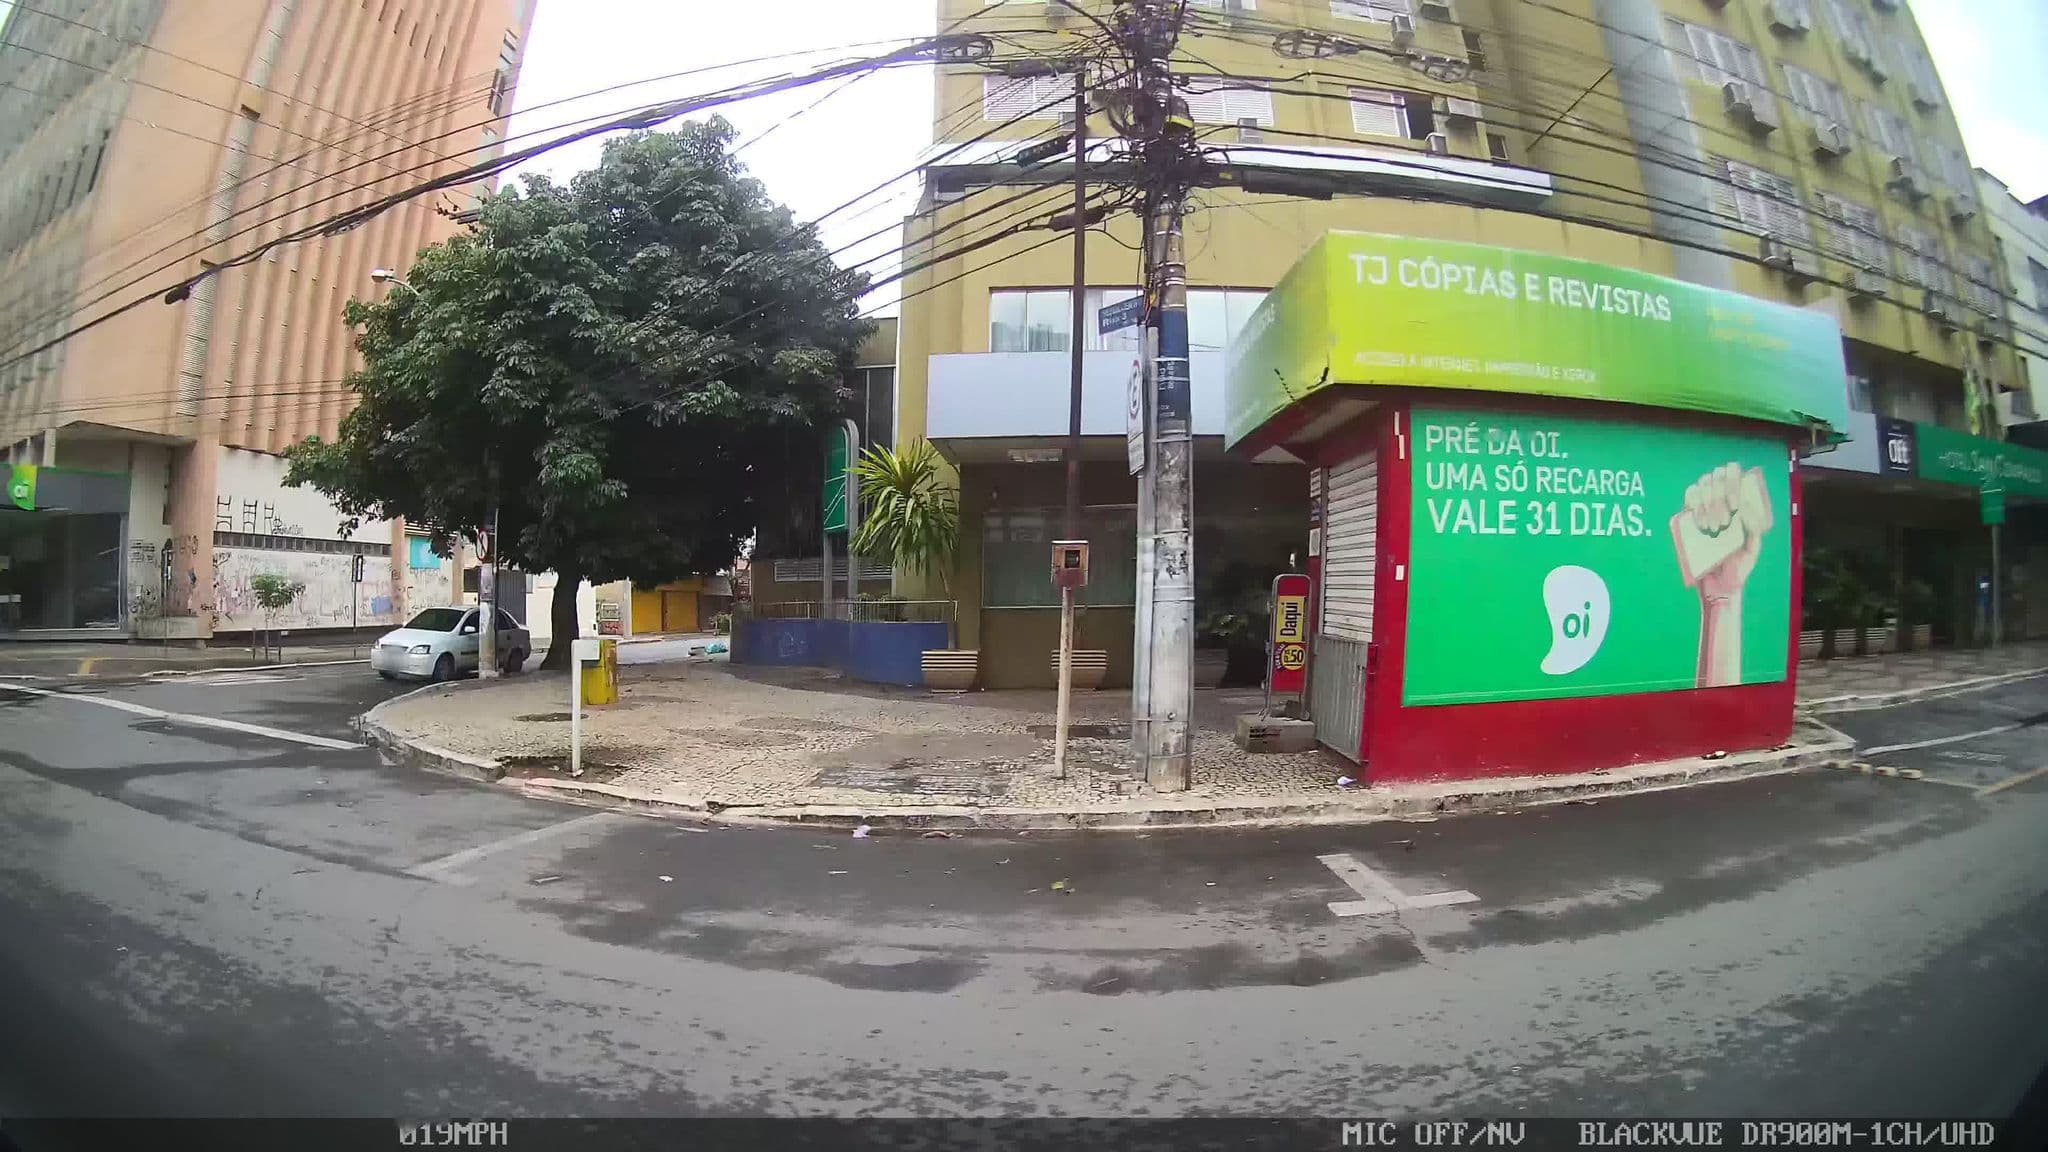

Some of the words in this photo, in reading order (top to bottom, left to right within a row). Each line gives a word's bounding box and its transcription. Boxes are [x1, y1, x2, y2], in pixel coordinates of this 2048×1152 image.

[1349, 254, 1388, 285] TJ
[1398, 255, 1518, 299] CÓPIAS
[1524, 273, 1542, 301] E
[1548, 276, 1672, 321] REVISTAS
[1426, 422, 1480, 454] PRÉ
[1488, 428, 1524, 456] DA
[1530, 431, 1568, 458] OI.
[1426, 462, 1488, 491] UMA
[1495, 460, 1528, 492] SÓ
[1536, 466, 1645, 496] RECARGA
[1427, 498, 1517, 534] VALE
[1526, 501, 1562, 535] 31
[1570, 502, 1652, 536] DIAS.
[1280, 602, 1302, 636] Daqui
[1563, 601, 1590, 639] oi
